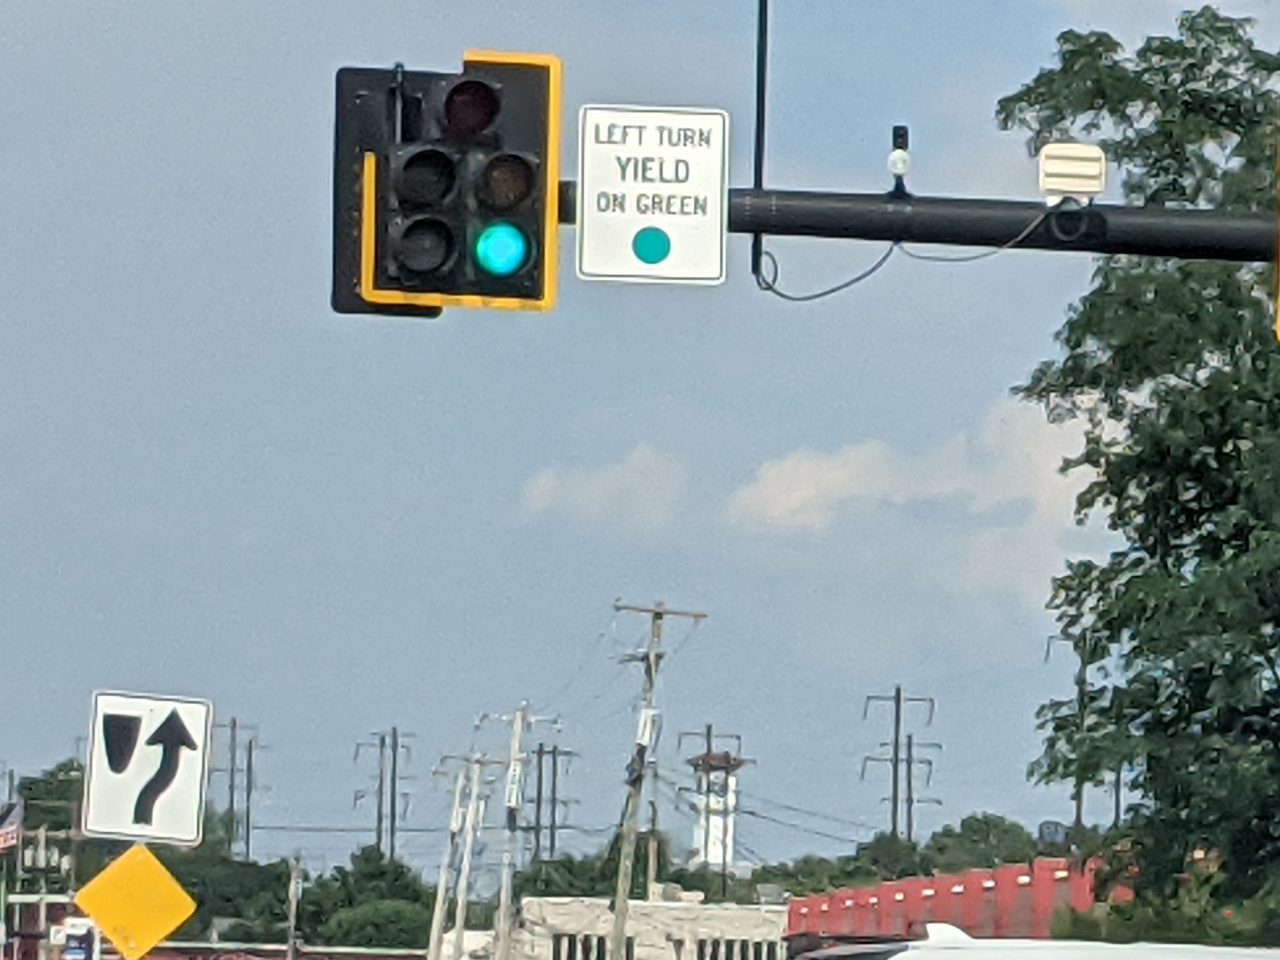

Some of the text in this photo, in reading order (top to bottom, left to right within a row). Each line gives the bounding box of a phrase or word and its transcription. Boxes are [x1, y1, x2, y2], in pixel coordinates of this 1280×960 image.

[594, 123, 712, 148] LEFT TURN
[615, 155, 690, 183] YIELD
[596, 191, 708, 216] ON GREEN
